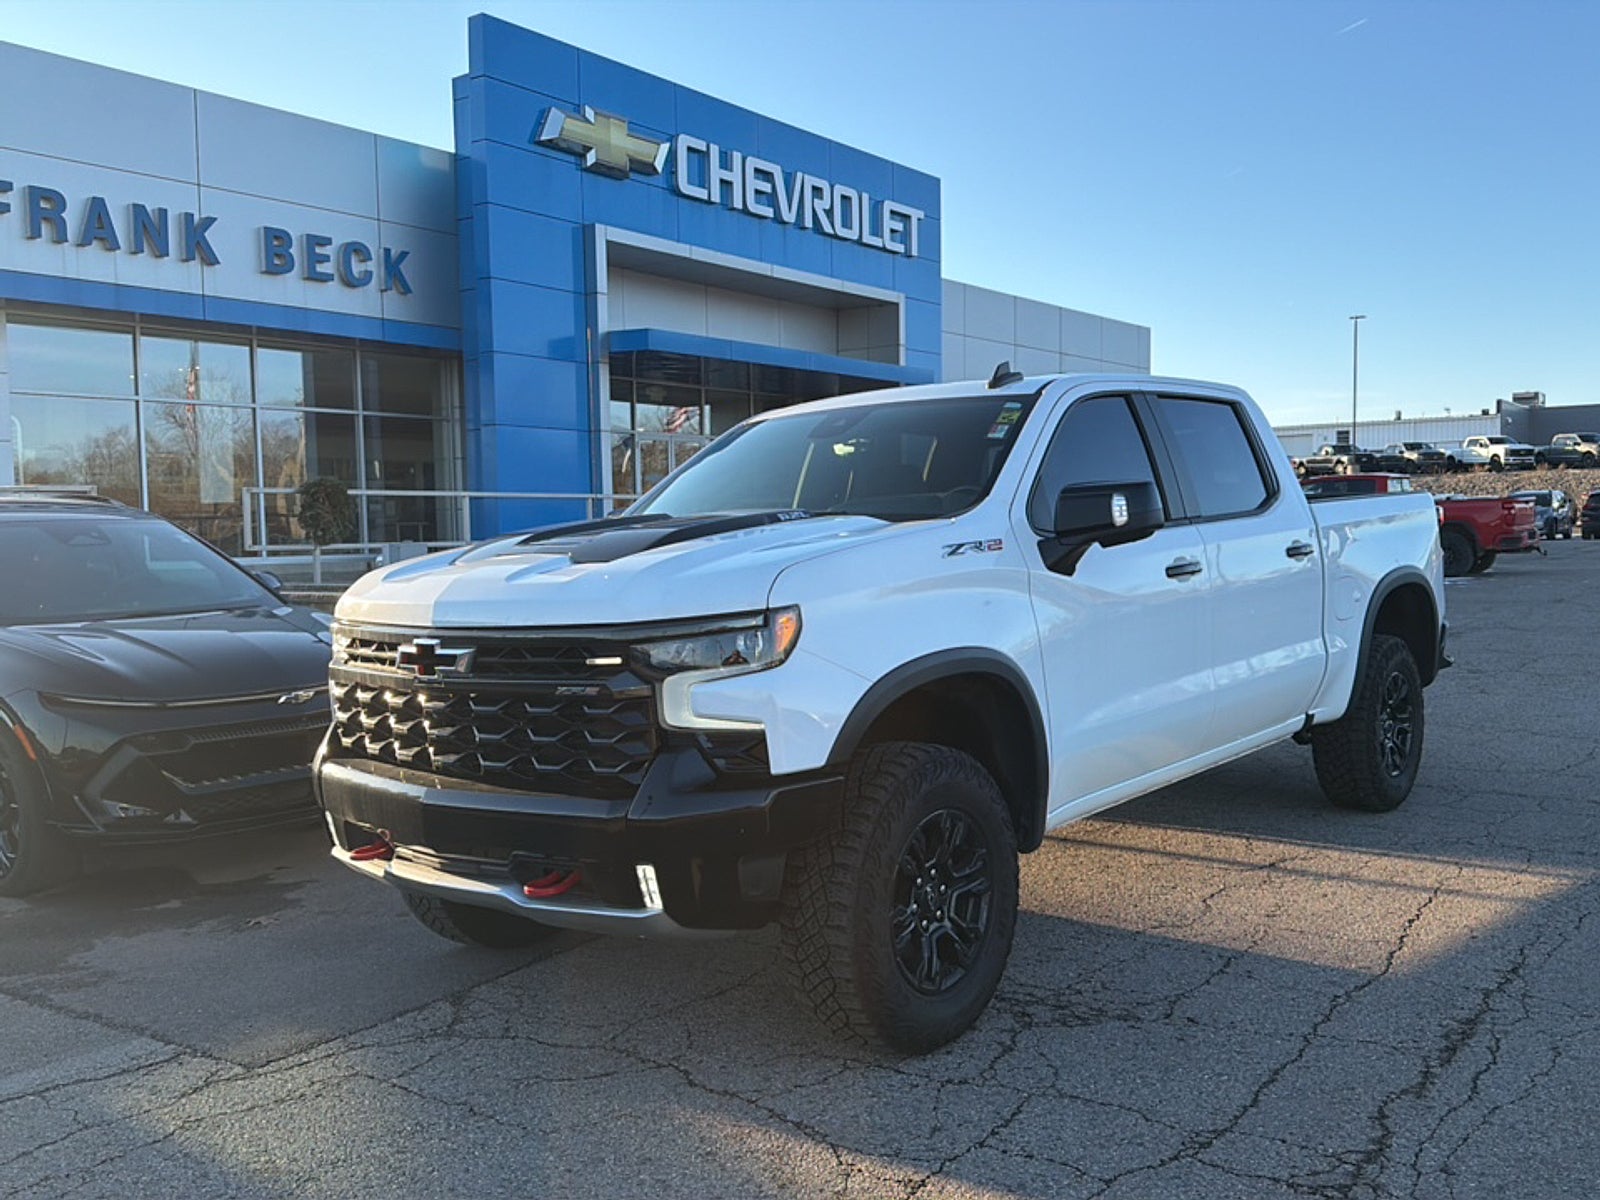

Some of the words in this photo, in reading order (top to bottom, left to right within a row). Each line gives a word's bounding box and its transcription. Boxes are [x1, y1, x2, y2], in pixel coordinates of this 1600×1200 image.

[675, 133, 925, 257] CHEVROLET
[259, 226, 413, 295] BECK
[941, 538, 1003, 559] ZR2
